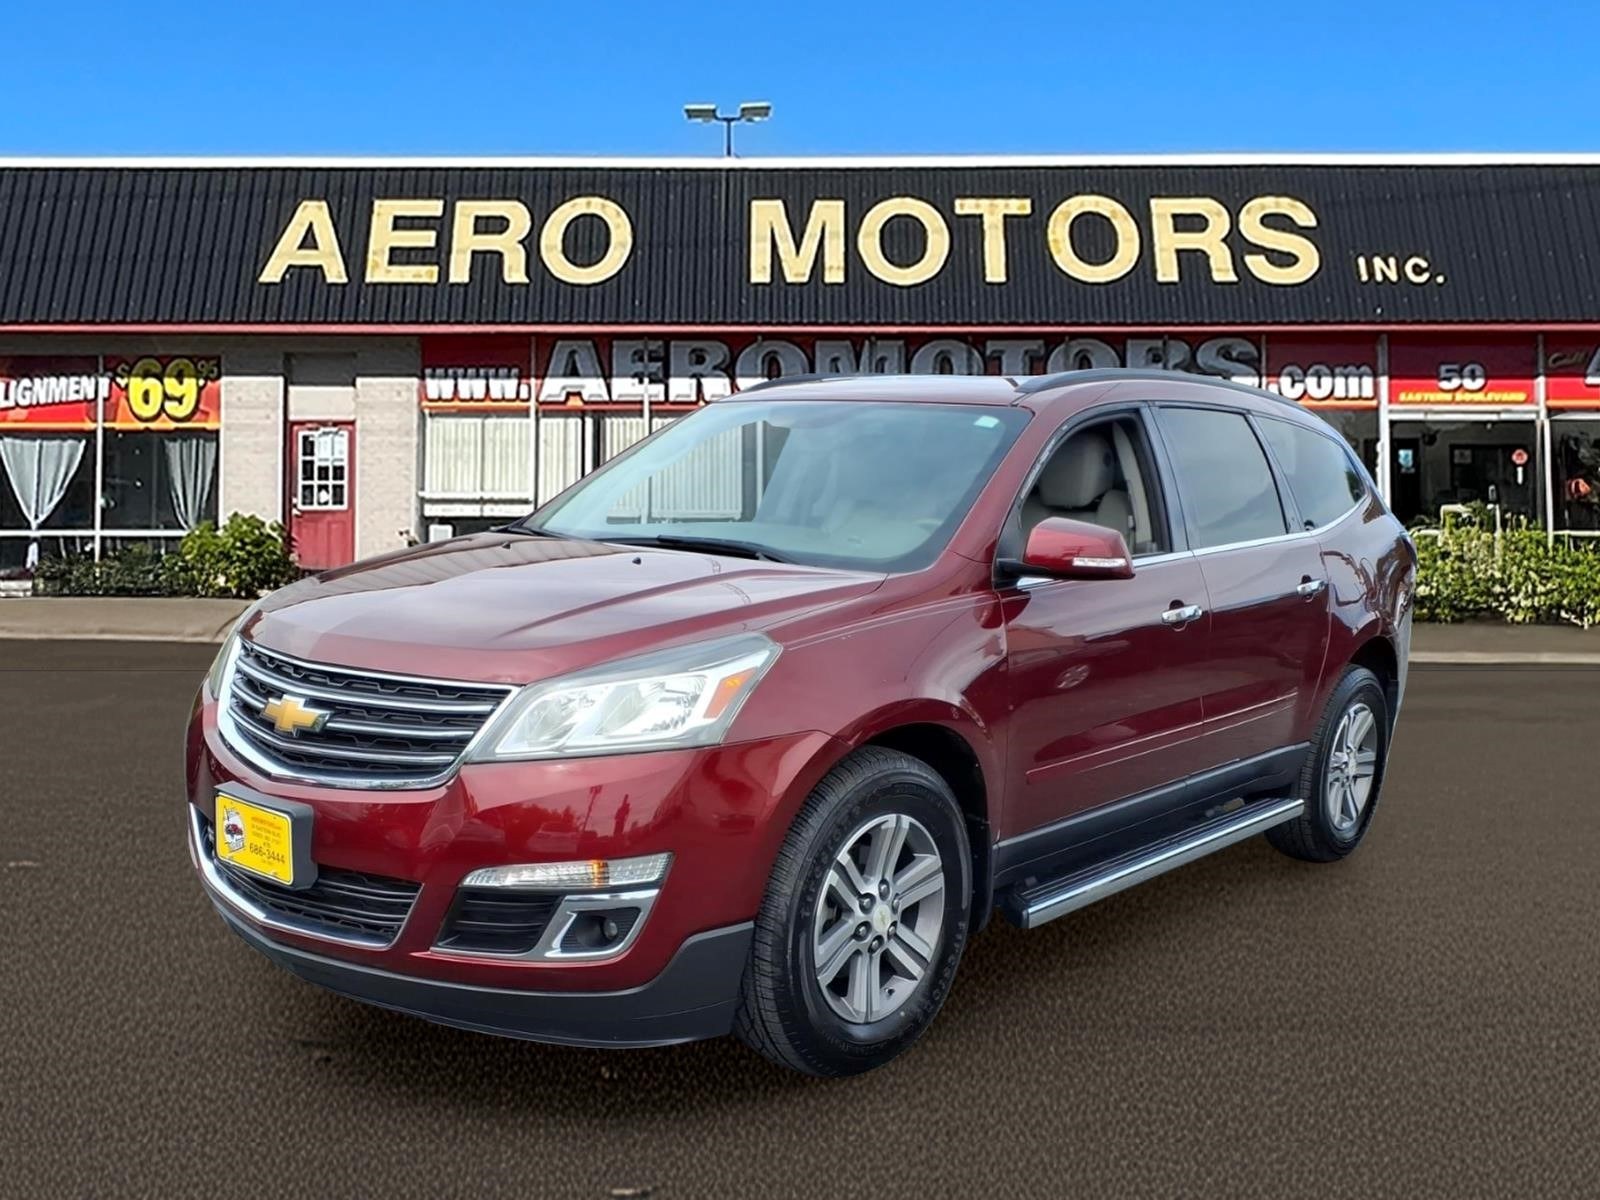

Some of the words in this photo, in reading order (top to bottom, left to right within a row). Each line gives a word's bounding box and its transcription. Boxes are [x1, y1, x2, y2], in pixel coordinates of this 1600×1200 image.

[257, 197, 634, 285] AERO
[749, 195, 1321, 286] MOTORS
[1357, 256, 1445, 283] INC.
[1437, 363, 1486, 391] 50
[249, 842, 286, 864] 686-3444
